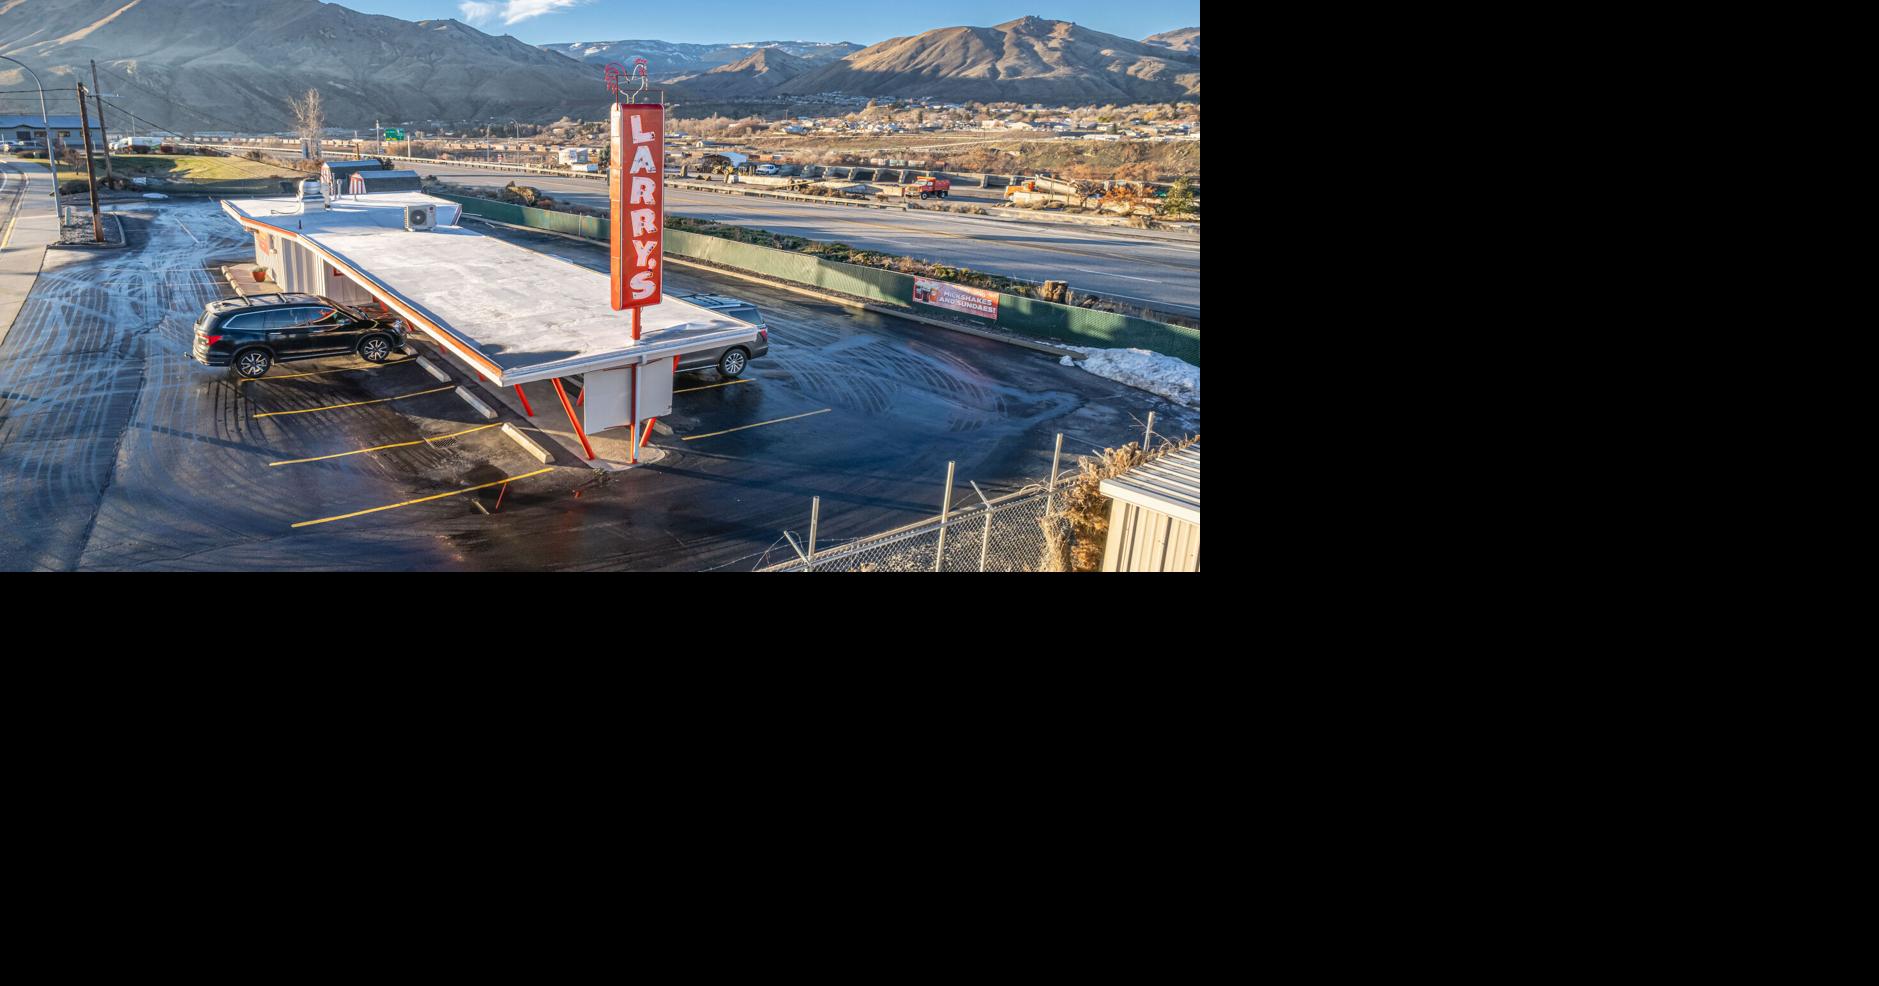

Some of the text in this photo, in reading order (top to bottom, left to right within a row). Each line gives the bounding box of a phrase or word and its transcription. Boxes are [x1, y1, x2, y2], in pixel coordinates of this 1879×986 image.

[938, 296, 996, 314] AND SUNDAES!
[943, 291, 993, 306] MILKSHAKES
